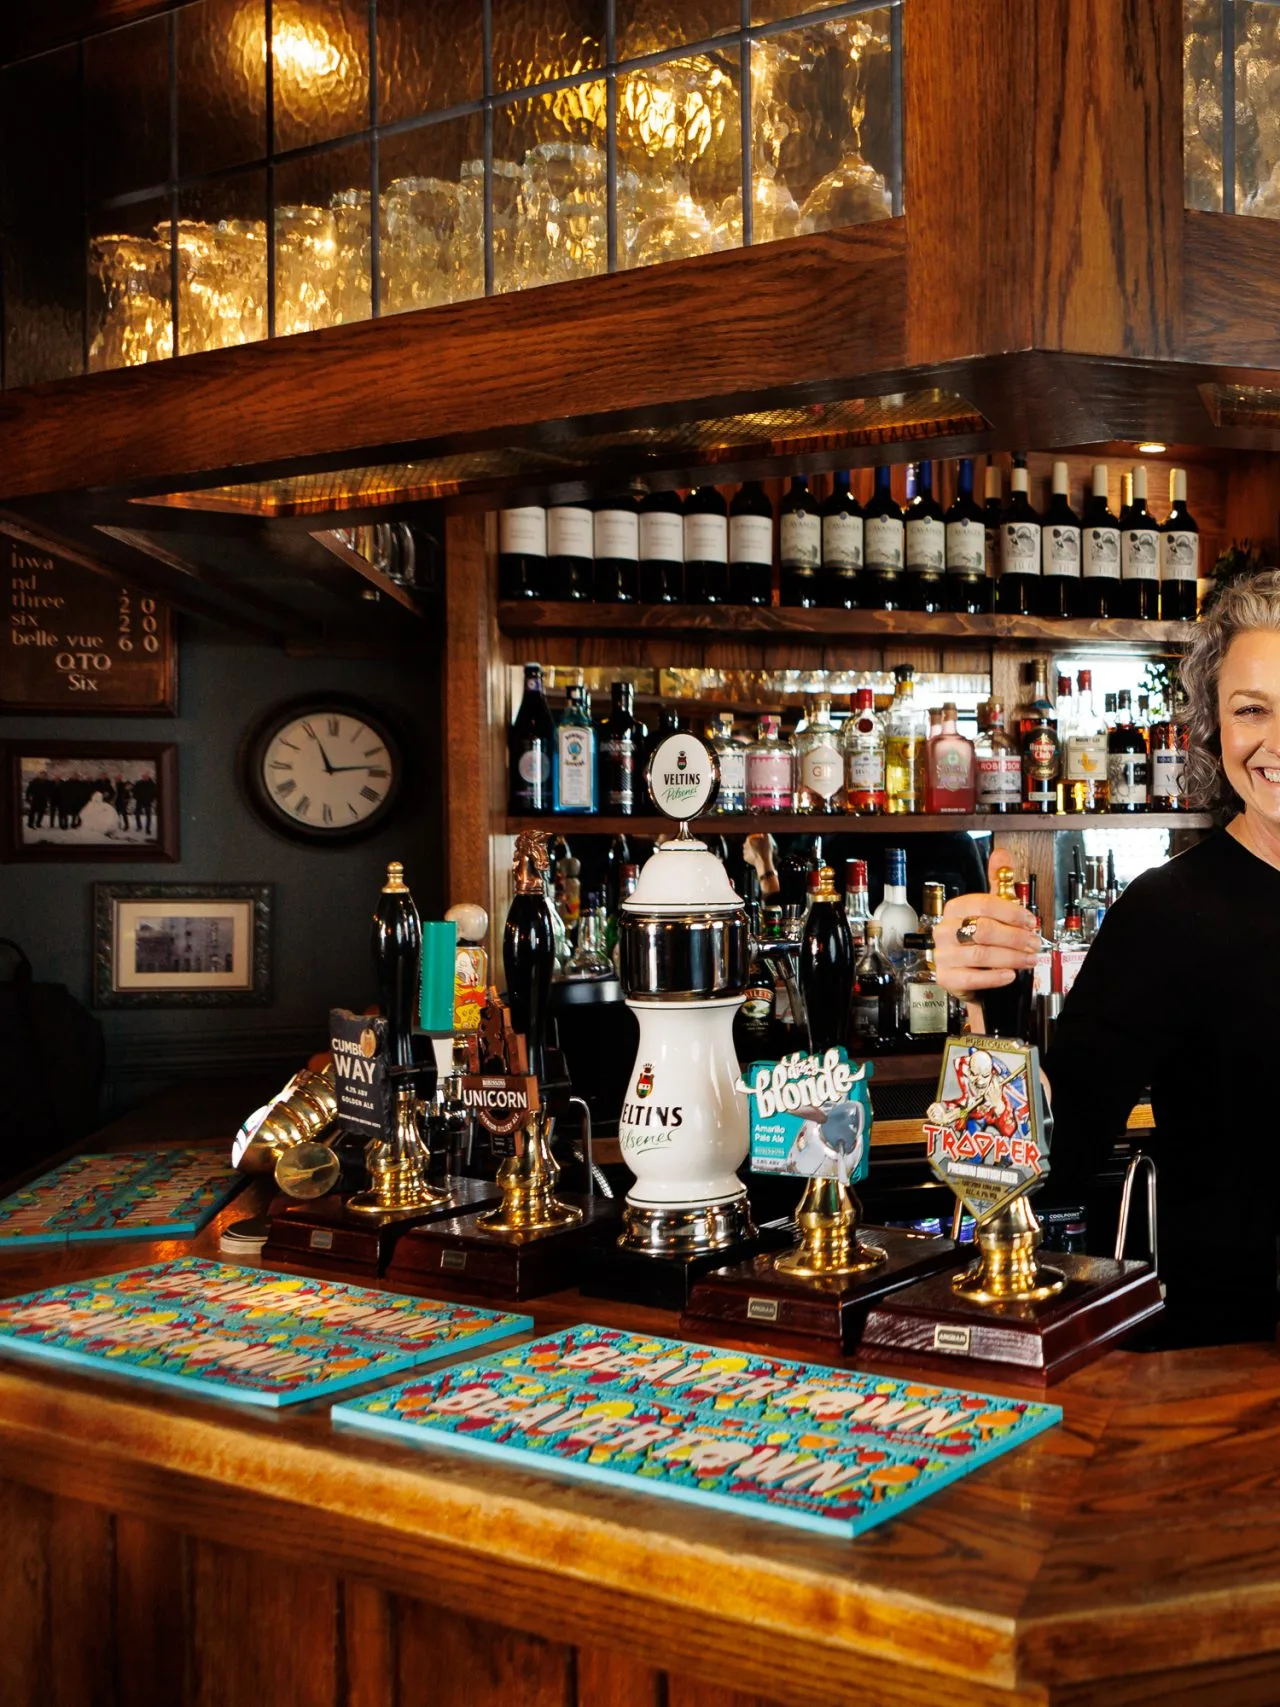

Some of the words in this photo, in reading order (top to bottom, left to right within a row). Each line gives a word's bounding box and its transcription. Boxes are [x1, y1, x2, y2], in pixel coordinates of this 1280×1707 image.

[11, 593, 65, 609] three
[11, 612, 39, 626] six
[11, 630, 58, 647] belle
[66, 636, 104, 648] vue
[118, 636, 133, 651] 6
[68, 674, 98, 690] Six
[663, 773, 701, 786] VELTINS
[331, 1038, 371, 1058] CUMBR
[333, 1053, 376, 1085] WAY
[735, 1047, 866, 1119] blonde
[463, 1089, 528, 1108] UNICORN
[621, 1103, 684, 1127] ELTINS
[754, 1124, 786, 1135] Amarillo
[754, 1133, 771, 1143] Pale
[922, 1123, 1043, 1178] TROOPER
[146, 1272, 452, 1338] BEAVERTOWN
[559, 1345, 968, 1436] BEAVERTOWN
[428, 1387, 866, 1493] BEAVERTOWN
